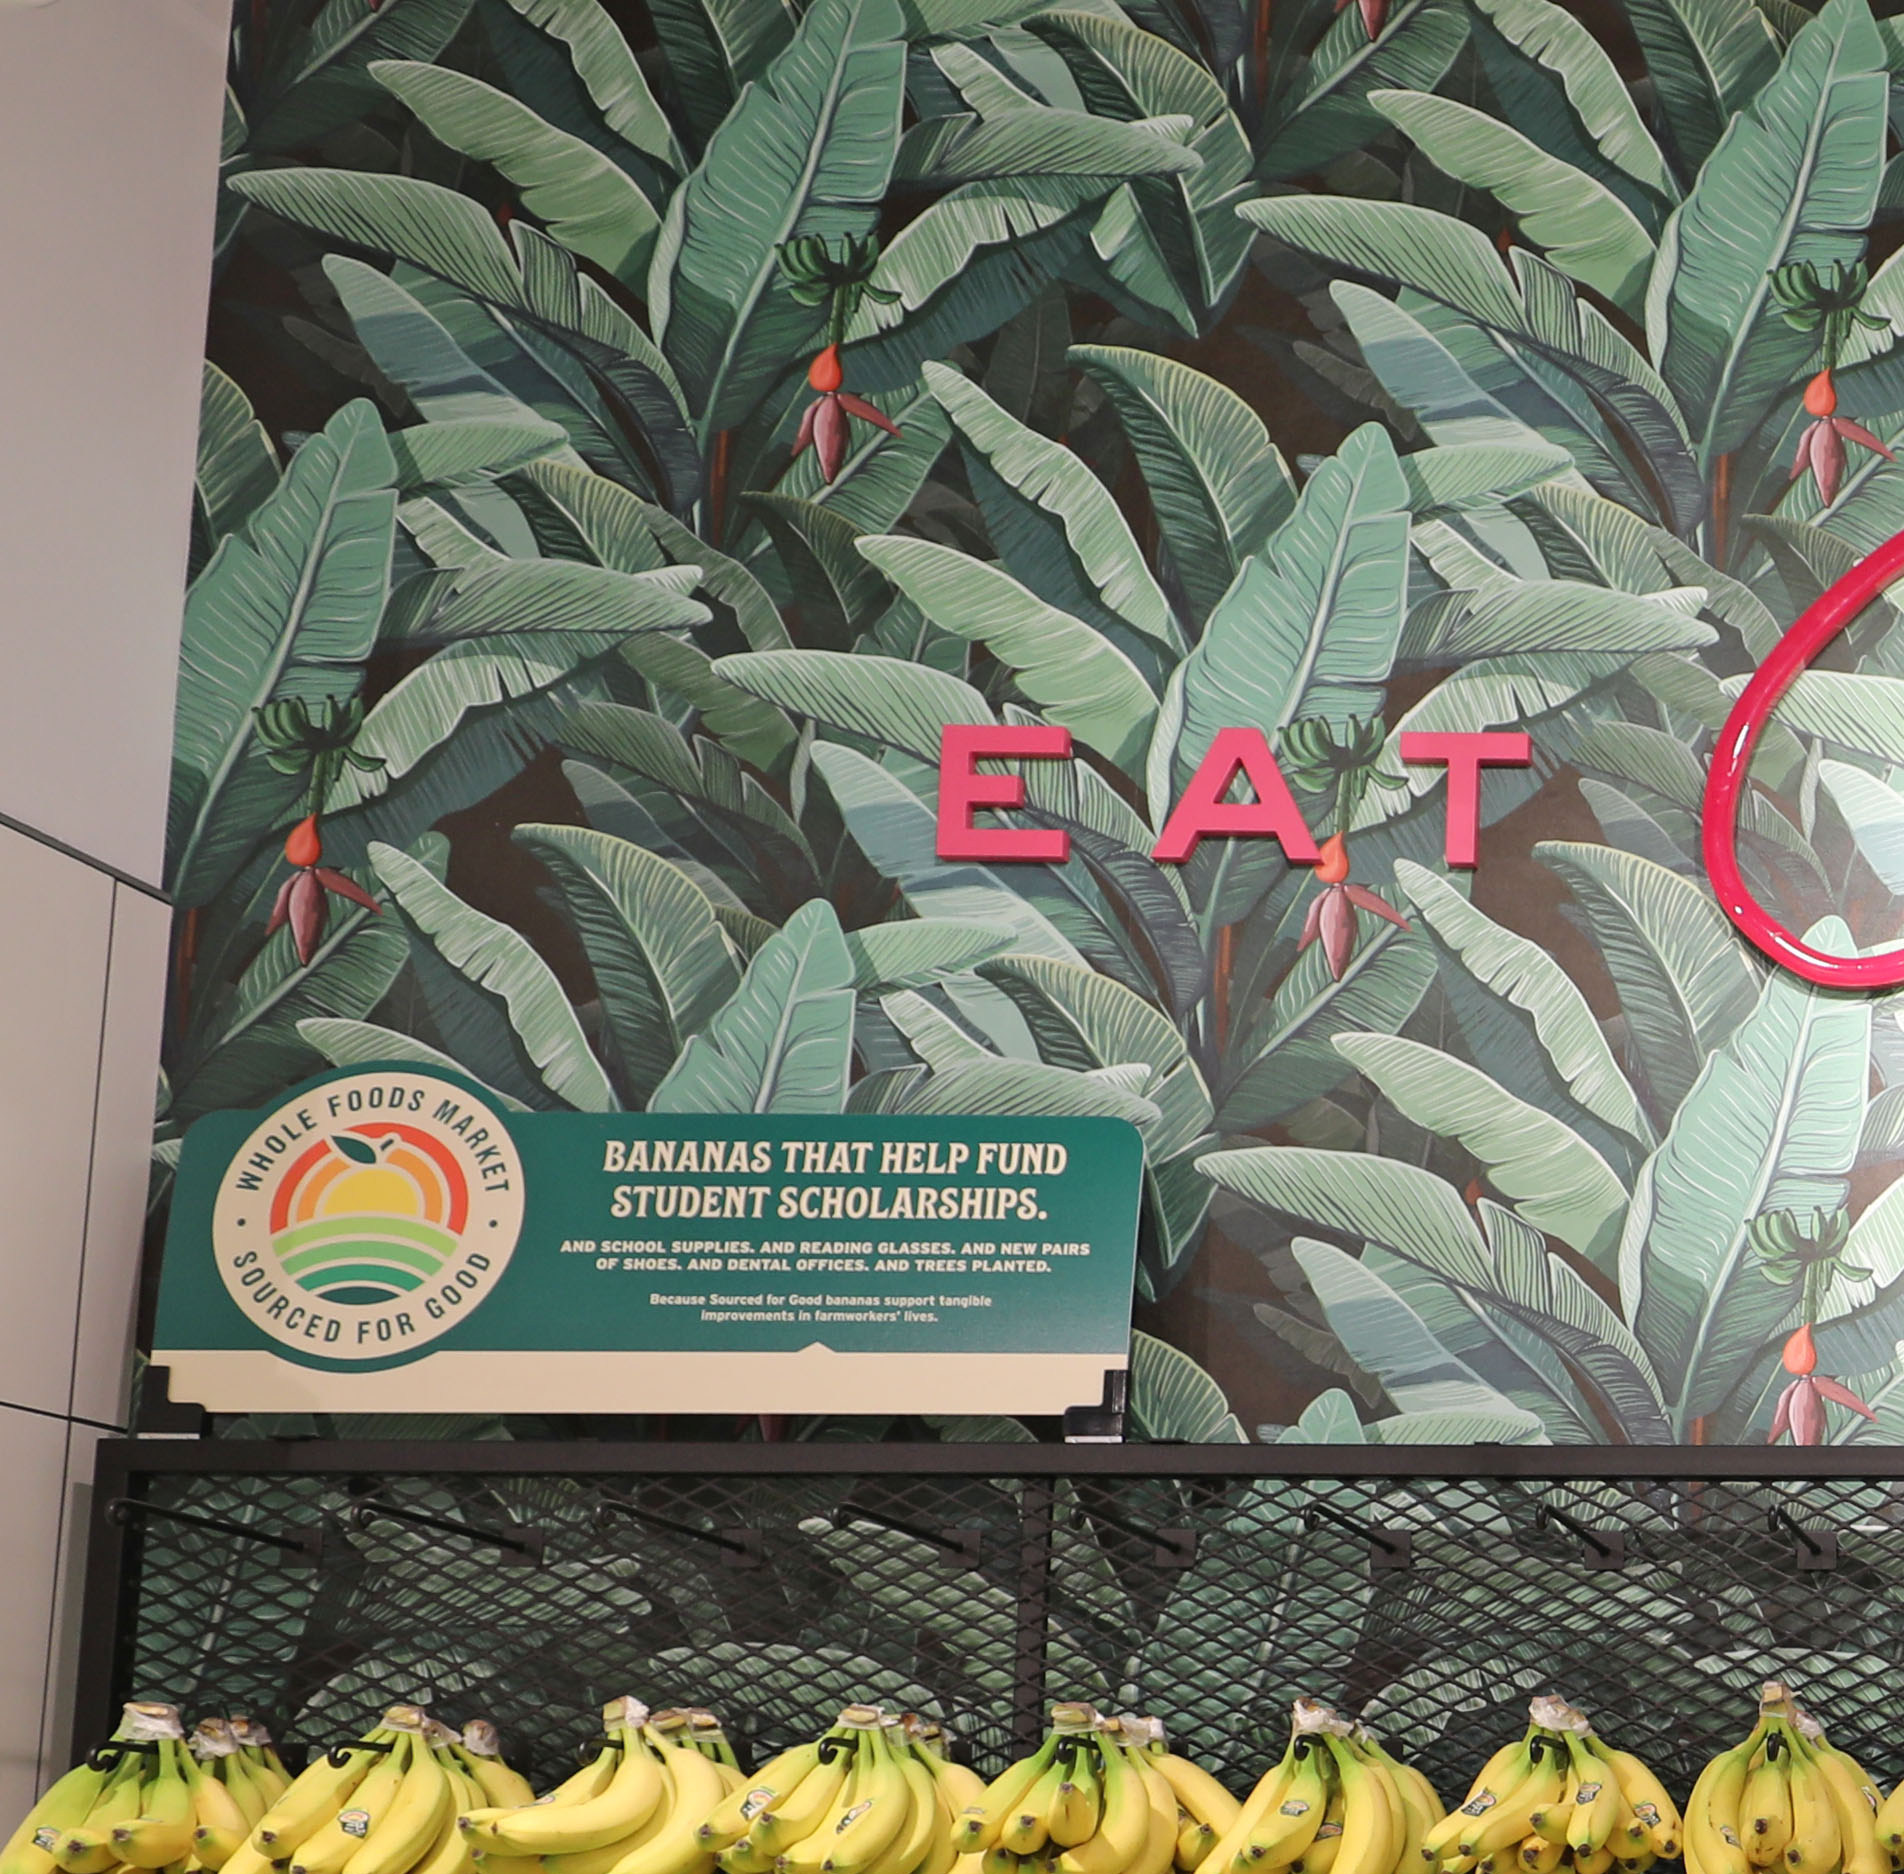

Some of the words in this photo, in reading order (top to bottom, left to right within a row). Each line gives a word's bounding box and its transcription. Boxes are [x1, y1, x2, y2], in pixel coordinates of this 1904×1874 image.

[935, 725, 1531, 869] EAT
[236, 1108, 317, 1191] WHOLE
[327, 1086, 425, 1117] FOODS
[432, 1099, 509, 1192] MARKET
[603, 1140, 771, 1173] BANANAS
[781, 1141, 873, 1173] THAT
[880, 1141, 969, 1174] HELP
[977, 1142, 1067, 1175] FUND
[610, 1185, 770, 1218] STUDENT
[778, 1187, 1048, 1220] SCHOLARSHIPS.
[561, 1240, 596, 1253] AND
[600, 1240, 666, 1253] SCHOOL
[671, 1240, 755, 1254] SUPPLIES.
[760, 1240, 795, 1254] AND
[800, 1240, 873, 1254] READING
[878, 1240, 956, 1255] GLASSES.
[961, 1240, 996, 1255] AND
[1001, 1240, 1038, 1255] NEW
[1042, 1240, 1090, 1256] PAIRS
[596, 1258, 619, 1272] OF
[623, 1258, 682, 1272] SHOES.
[687, 1258, 722, 1272] AND
[728, 1258, 791, 1272] DENTAL
[796, 1258, 869, 1272] OFFICES.
[874, 1258, 910, 1272] AND
[915, 1258, 967, 1272] TREES
[972, 1258, 1052, 1272] PLANTED.
[233, 1250, 340, 1342] SOURCED
[358, 1312, 415, 1344] FOR
[424, 1252, 490, 1319] GOOD
[650, 1294, 705, 1306] Because
[710, 1294, 762, 1306] Sourced
[766, 1294, 785, 1306] for
[789, 1294, 822, 1306] Good
[826, 1294, 880, 1306] bananas
[884, 1296, 935, 1309] support
[939, 1295, 992, 1309] tangible
[701, 1310, 794, 1323] improvements
[798, 1310, 812, 1321] in
[904, 1310, 938, 1322] lives.
